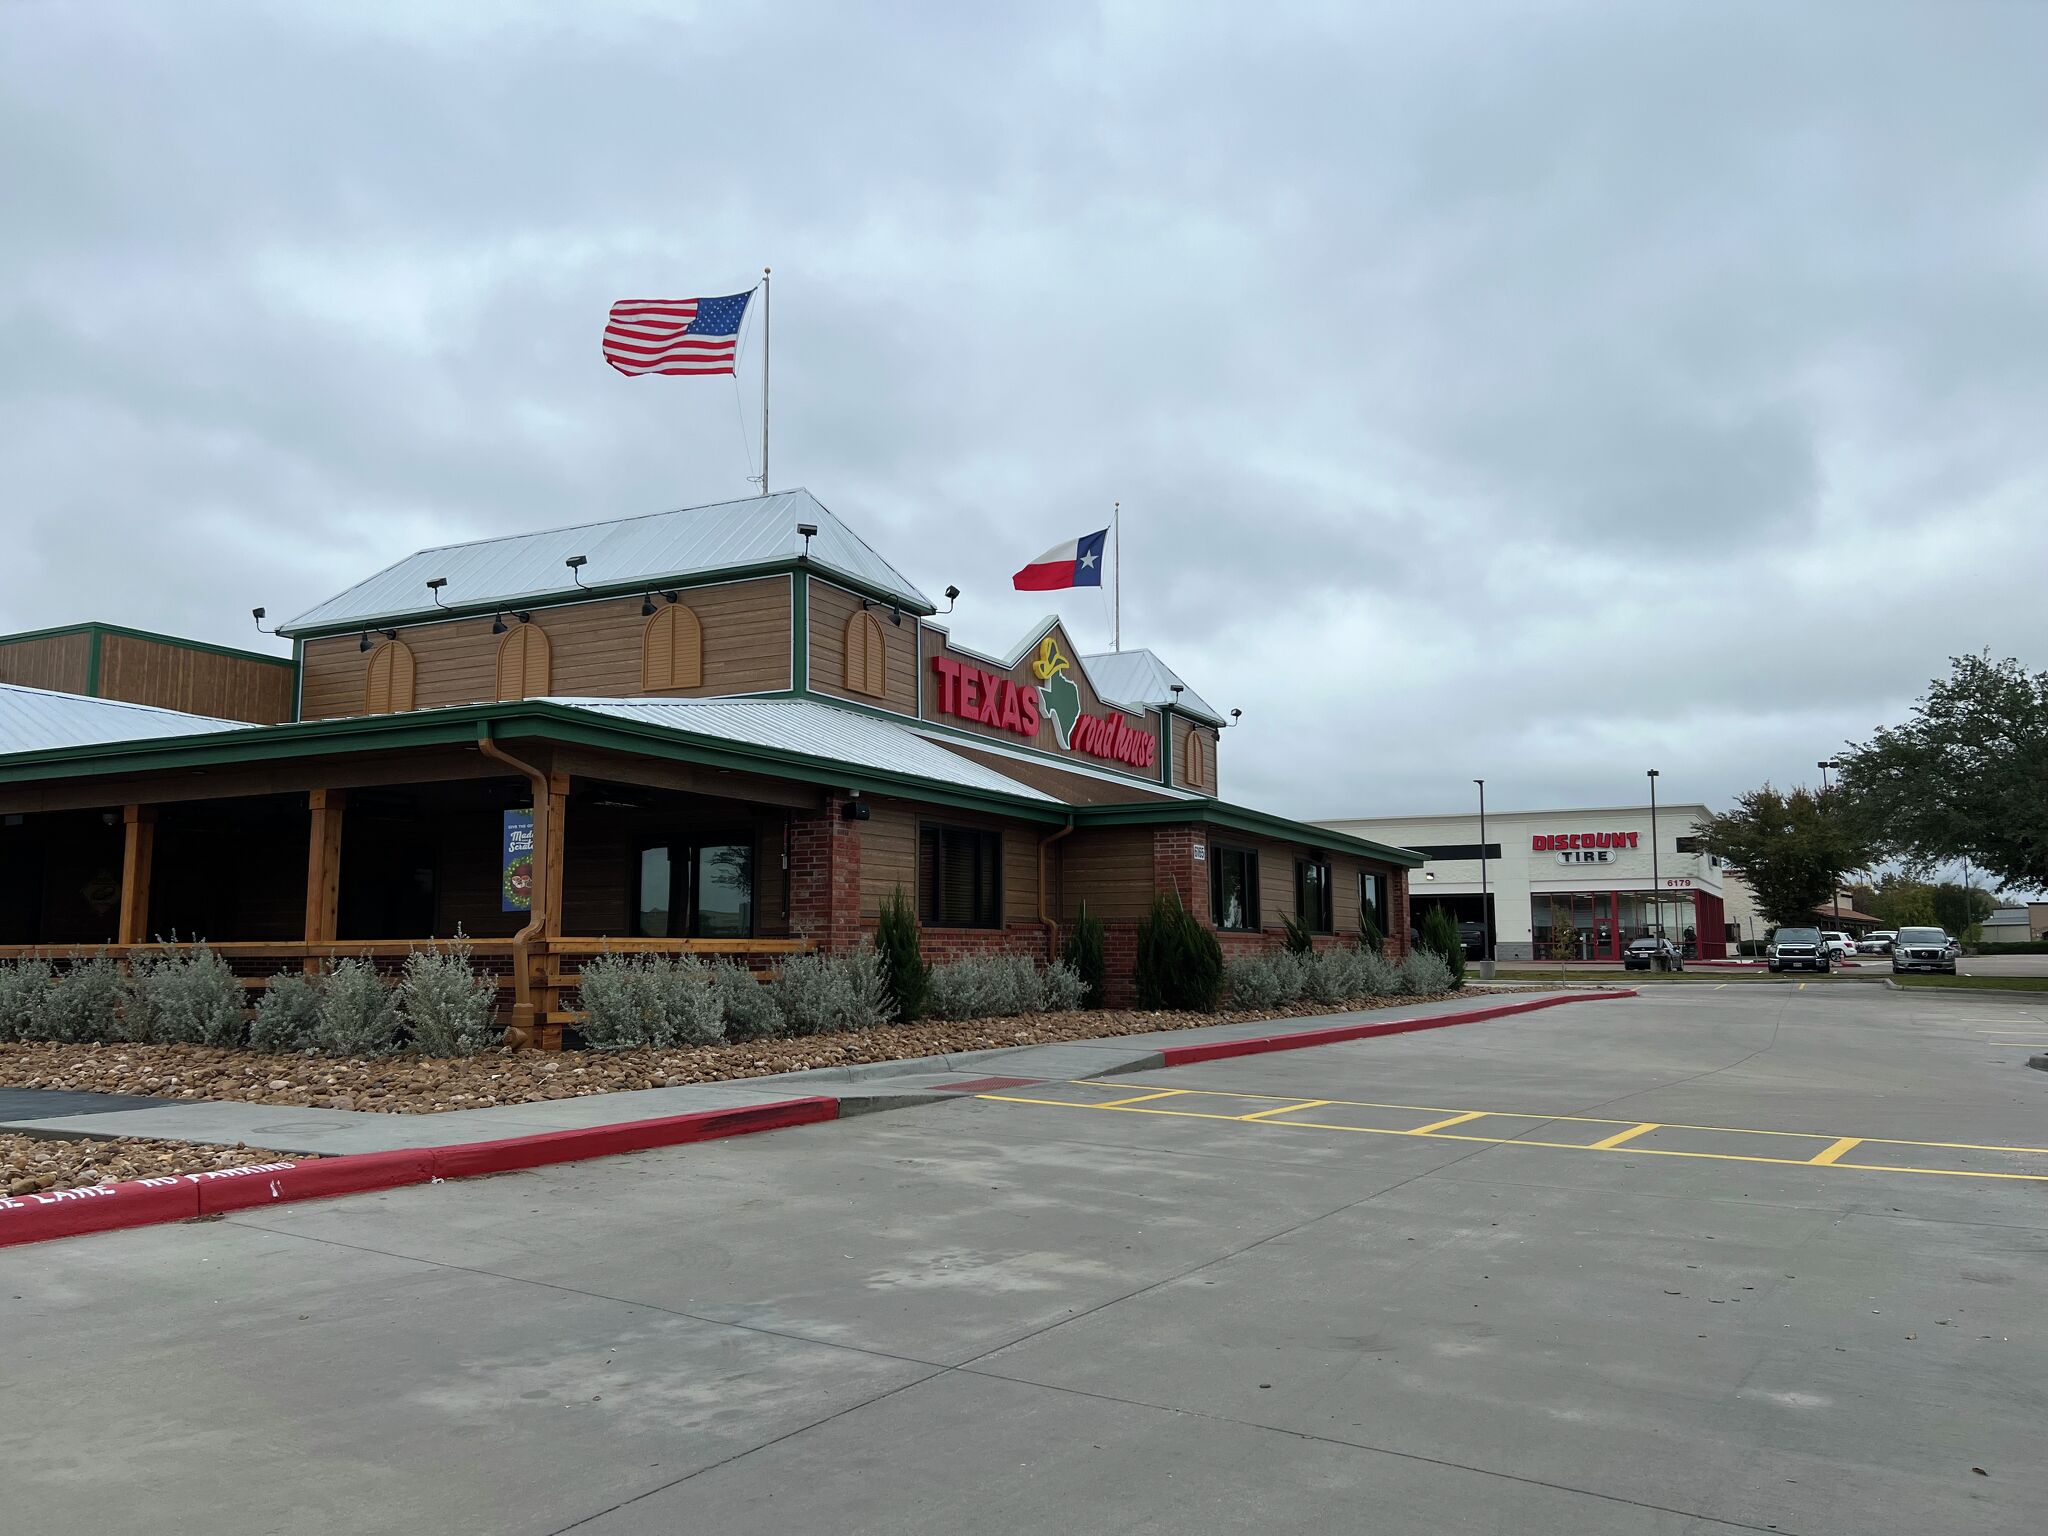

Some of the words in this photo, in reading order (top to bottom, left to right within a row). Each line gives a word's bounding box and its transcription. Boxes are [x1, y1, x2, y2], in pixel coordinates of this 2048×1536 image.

[932, 656, 1040, 736] TEXAS
[1532, 831, 1638, 850] DISCOUNT
[1562, 851, 1608, 862] TIRE
[28, 1185, 116, 1204] LANE
[136, 1173, 178, 1188] NO
